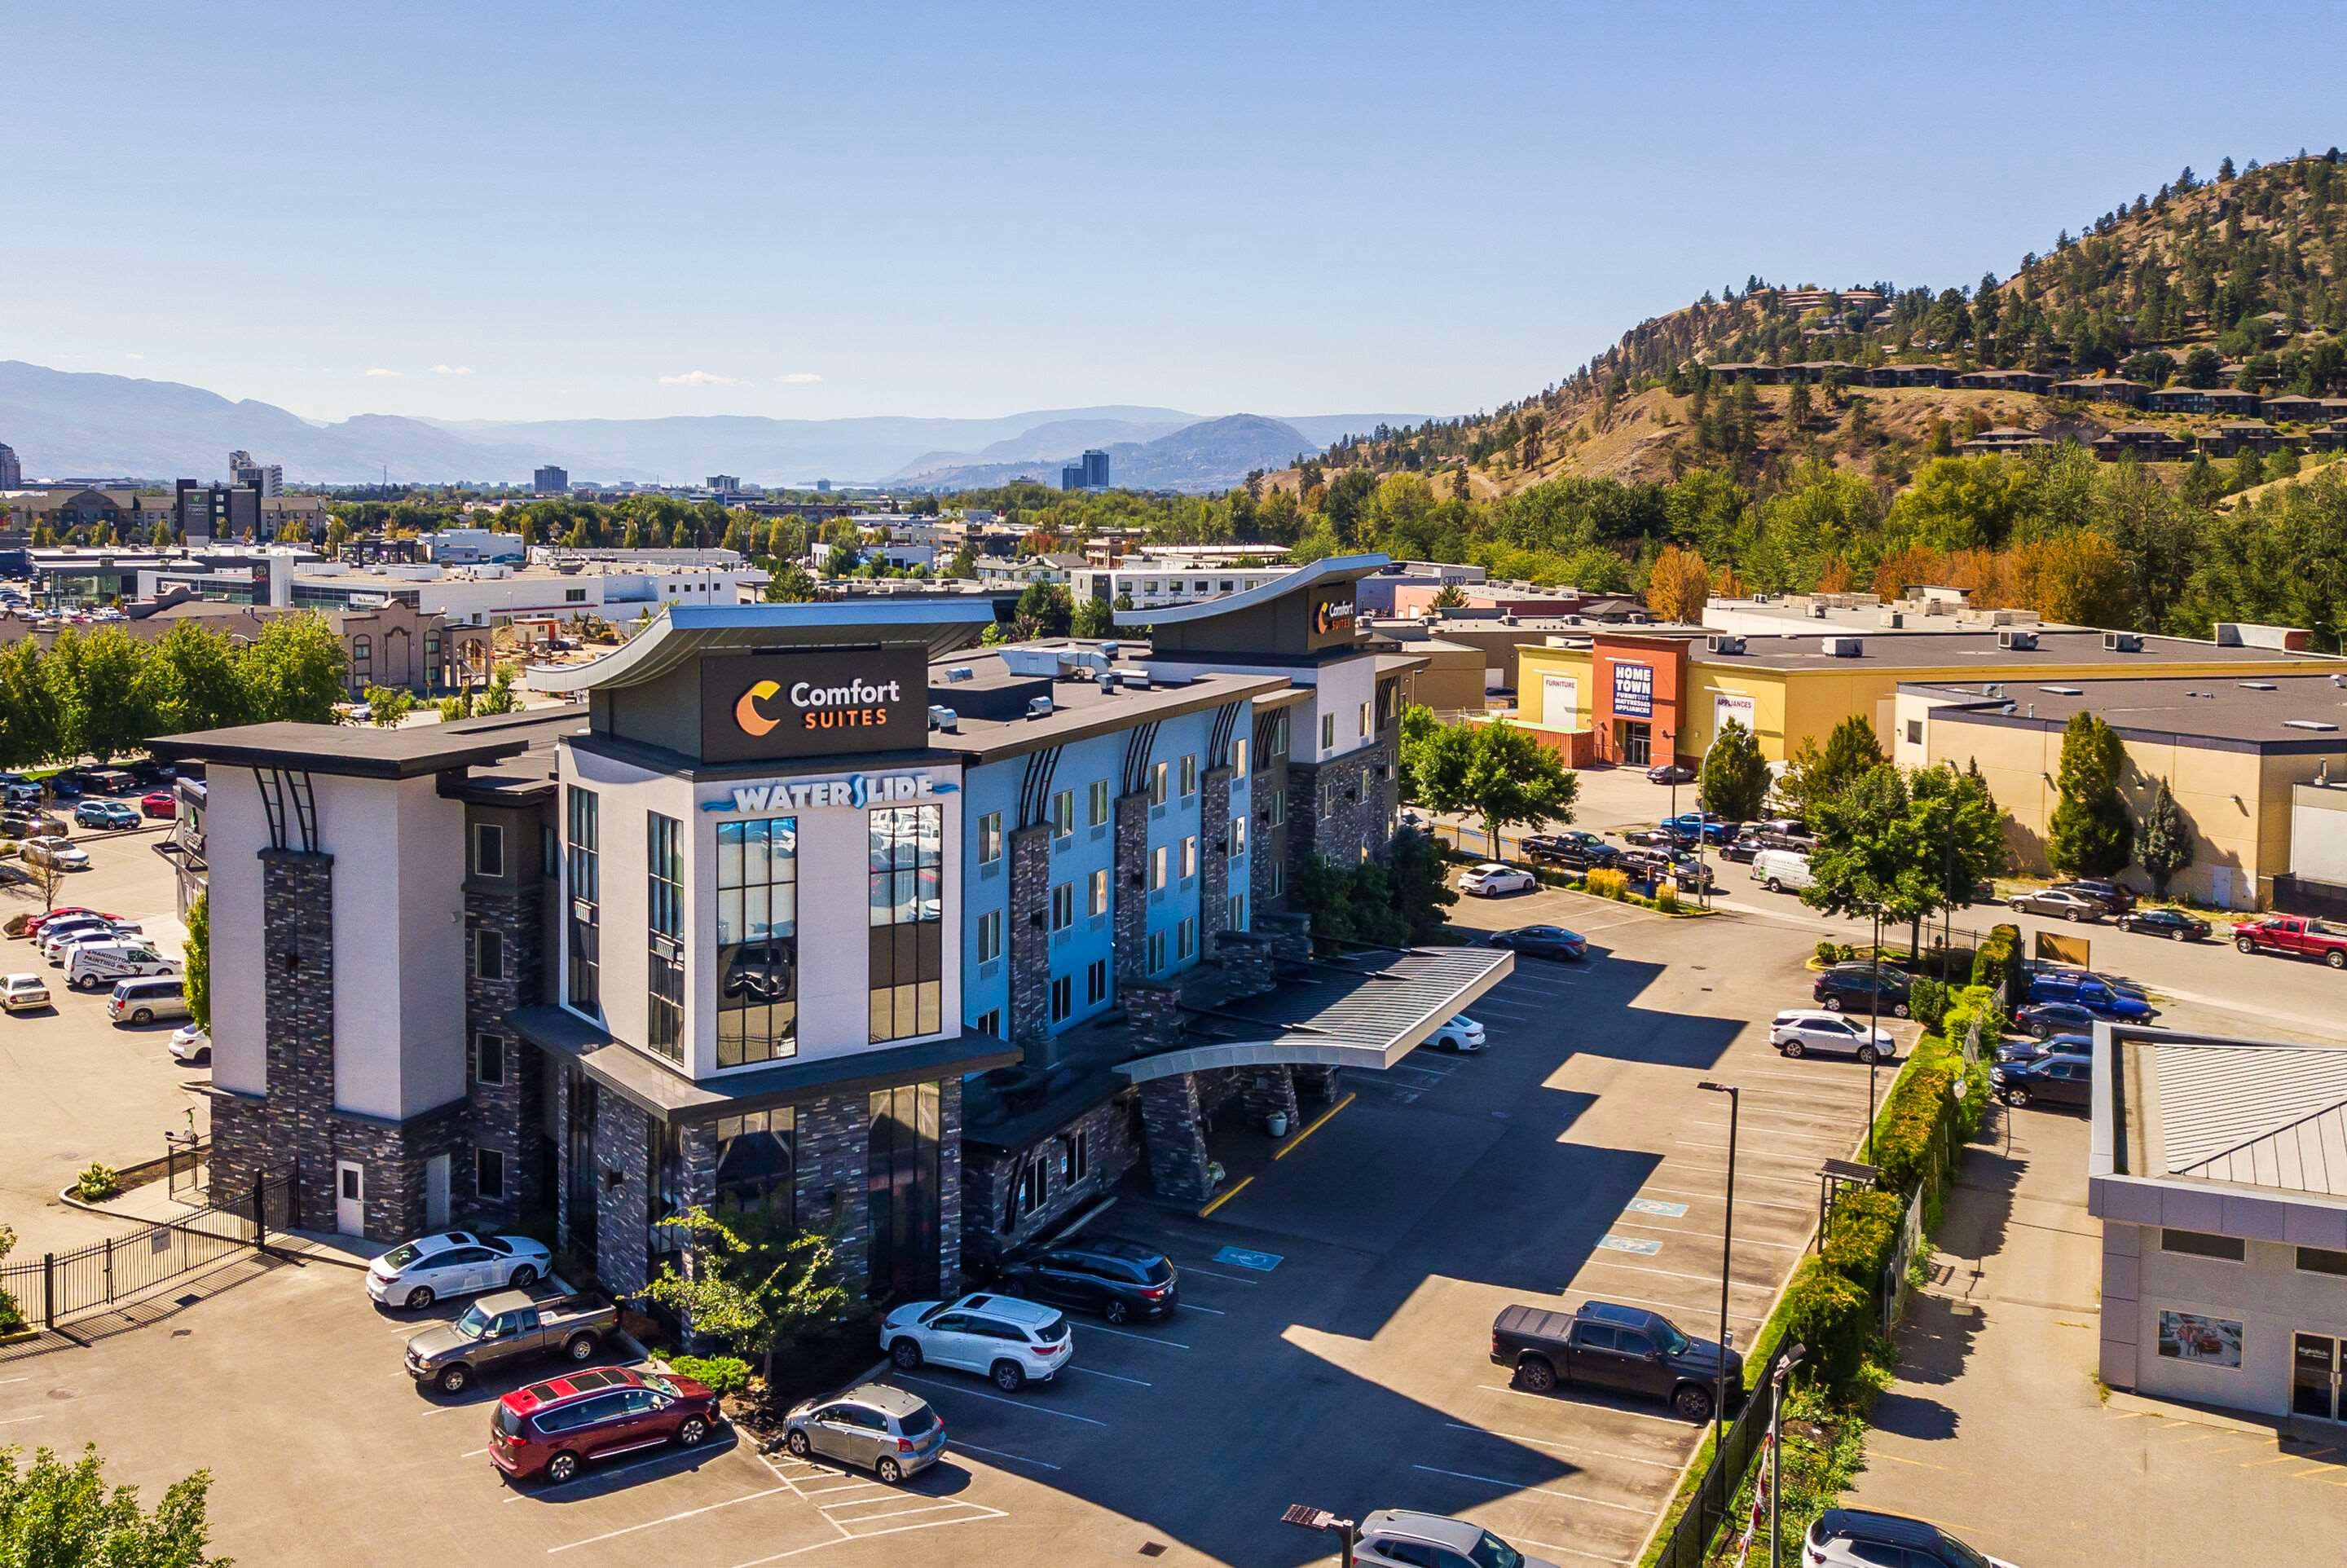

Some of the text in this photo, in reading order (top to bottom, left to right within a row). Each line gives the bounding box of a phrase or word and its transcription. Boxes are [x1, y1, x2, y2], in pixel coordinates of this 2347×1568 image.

[1329, 601, 1354, 618] Comfort
[1616, 667, 1651, 681] HOME
[1546, 680, 1575, 688] FURNITURE
[1616, 680, 1651, 694] TOWN
[790, 678, 900, 707] Comfort
[1617, 692, 1649, 701] FURNITURE
[1615, 704, 1650, 713] APPLIANCES
[1718, 698, 1751, 708] APPLIANCES
[805, 708, 887, 729] SUITES
[733, 774, 934, 813] WATERSLIDE
